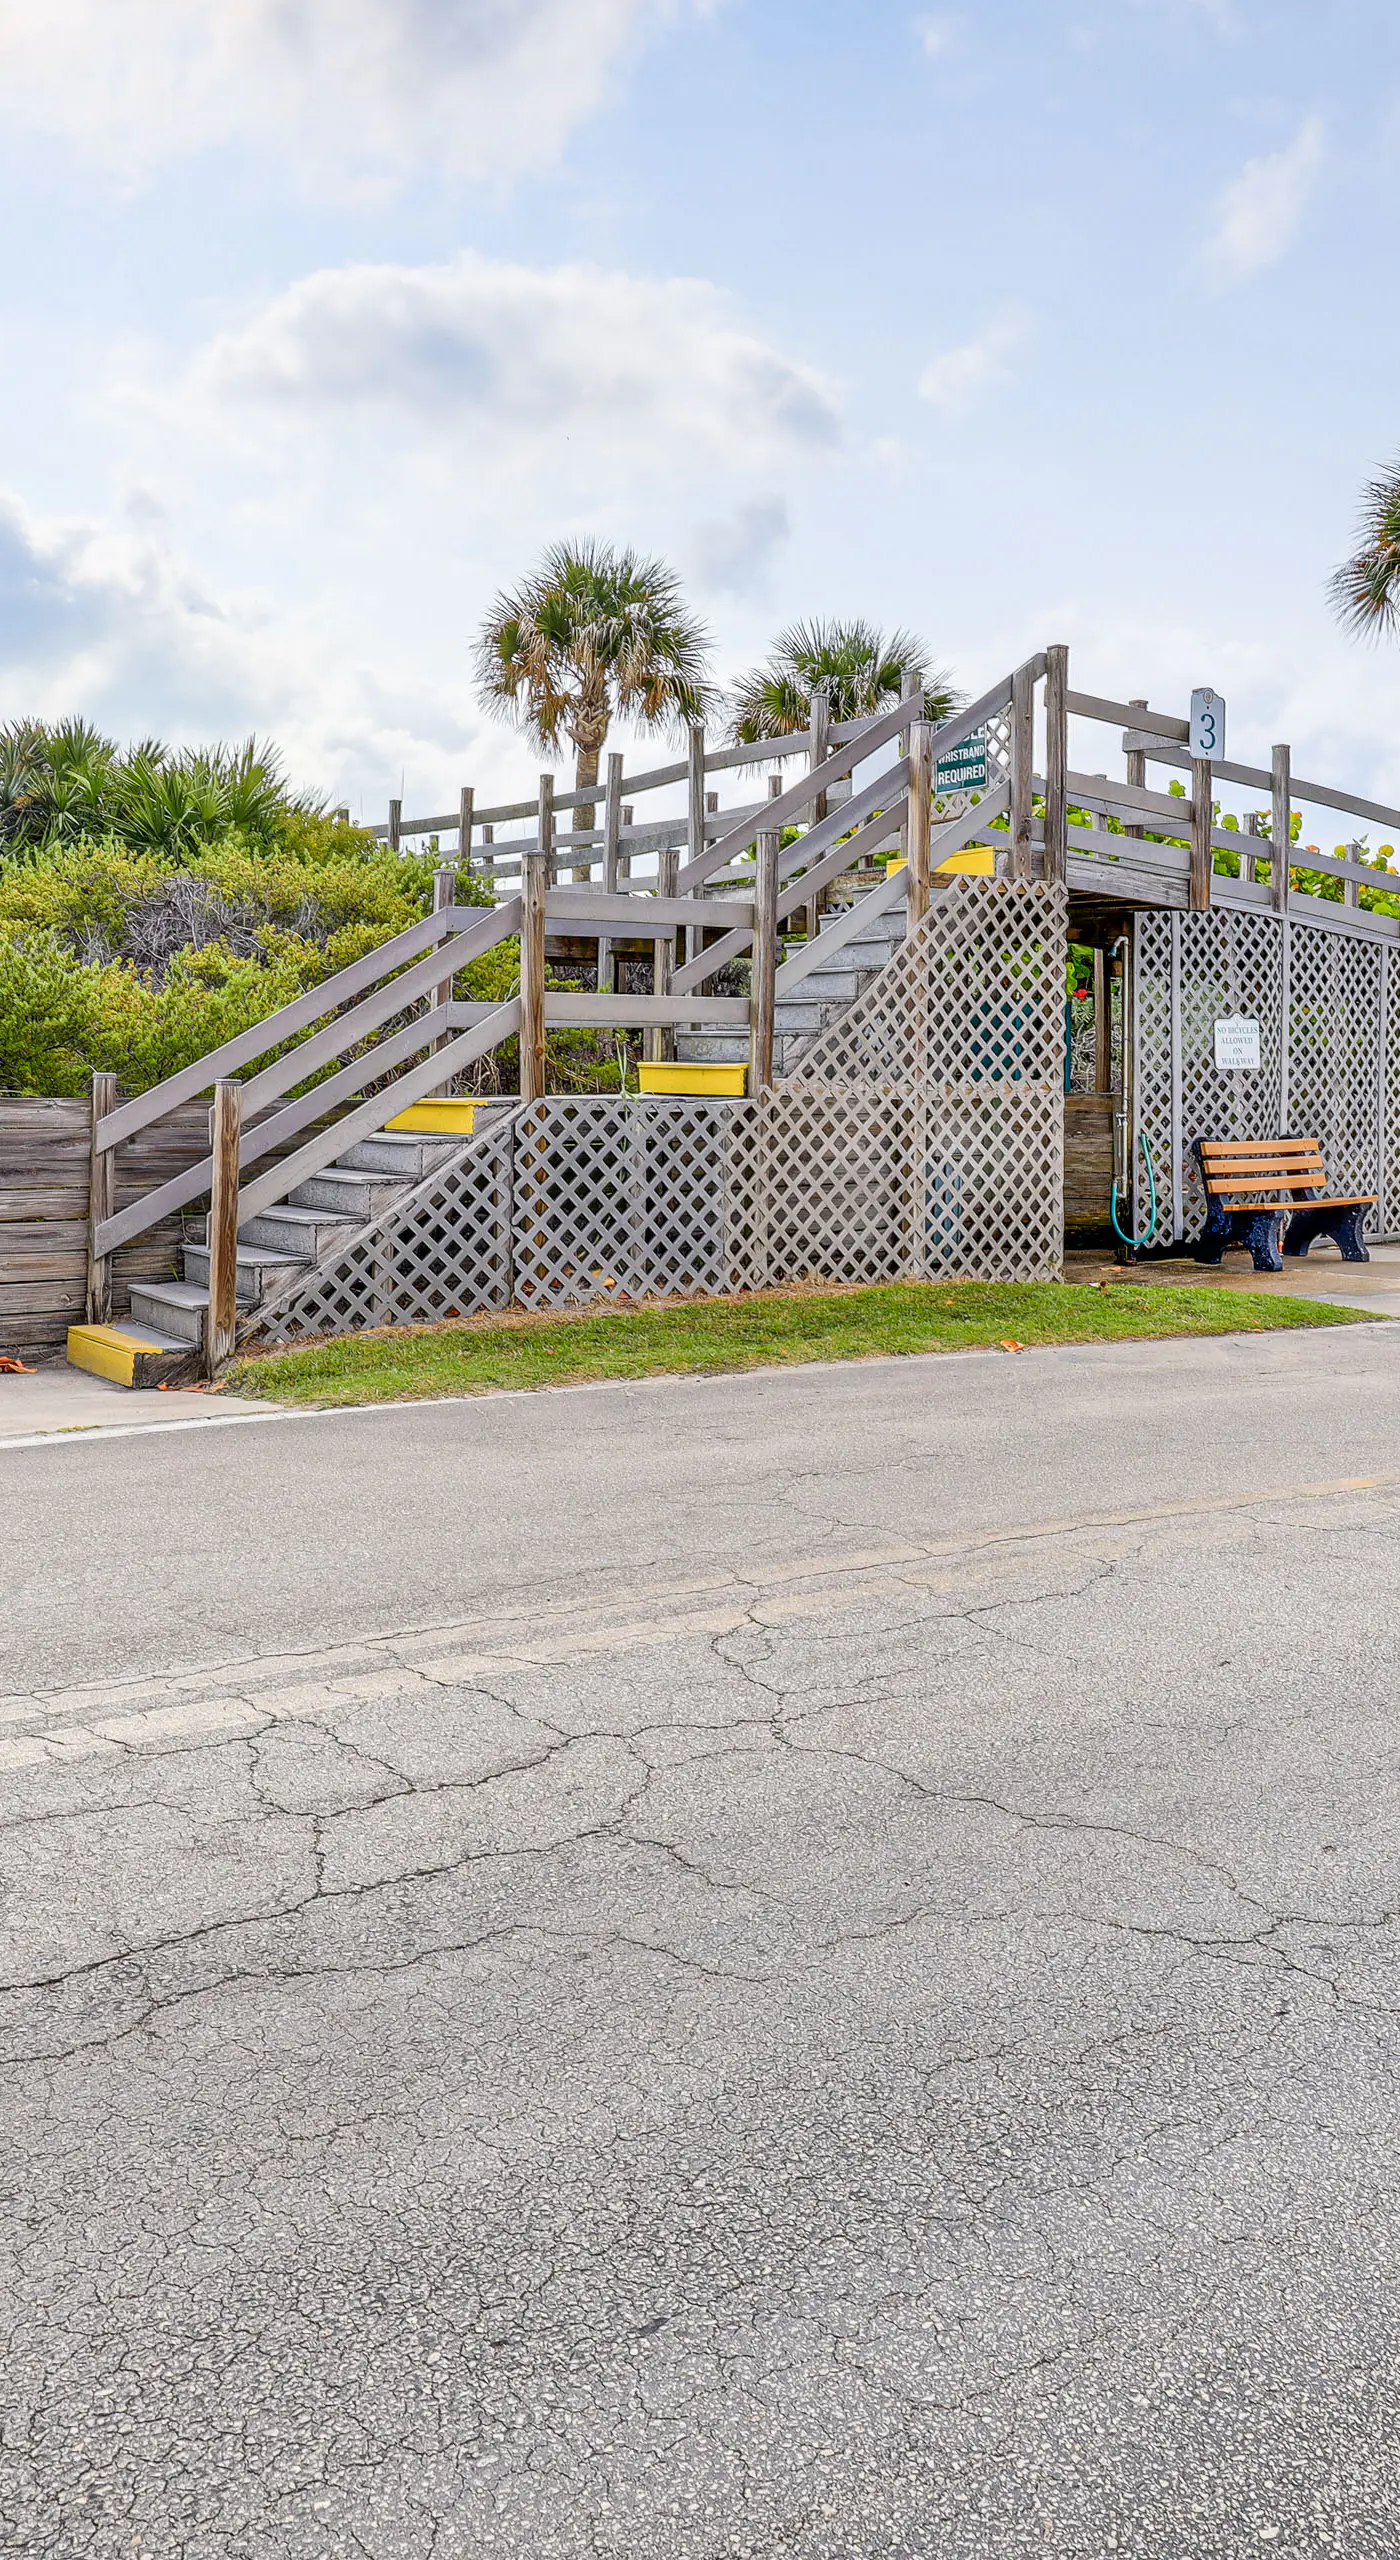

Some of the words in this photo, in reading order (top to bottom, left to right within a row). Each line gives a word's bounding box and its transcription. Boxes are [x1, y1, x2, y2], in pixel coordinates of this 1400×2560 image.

[1200, 713, 1216, 750] 3
[938, 763, 985, 785] REQUIRED
[1217, 1026, 1227, 1034] NO
[1228, 1026, 1258, 1034] BICYCLES
[1221, 1037, 1253, 1045] ALLOWED
[1233, 1047, 1243, 1055] ON
[1221, 1057, 1254, 1065] WALKWAY
